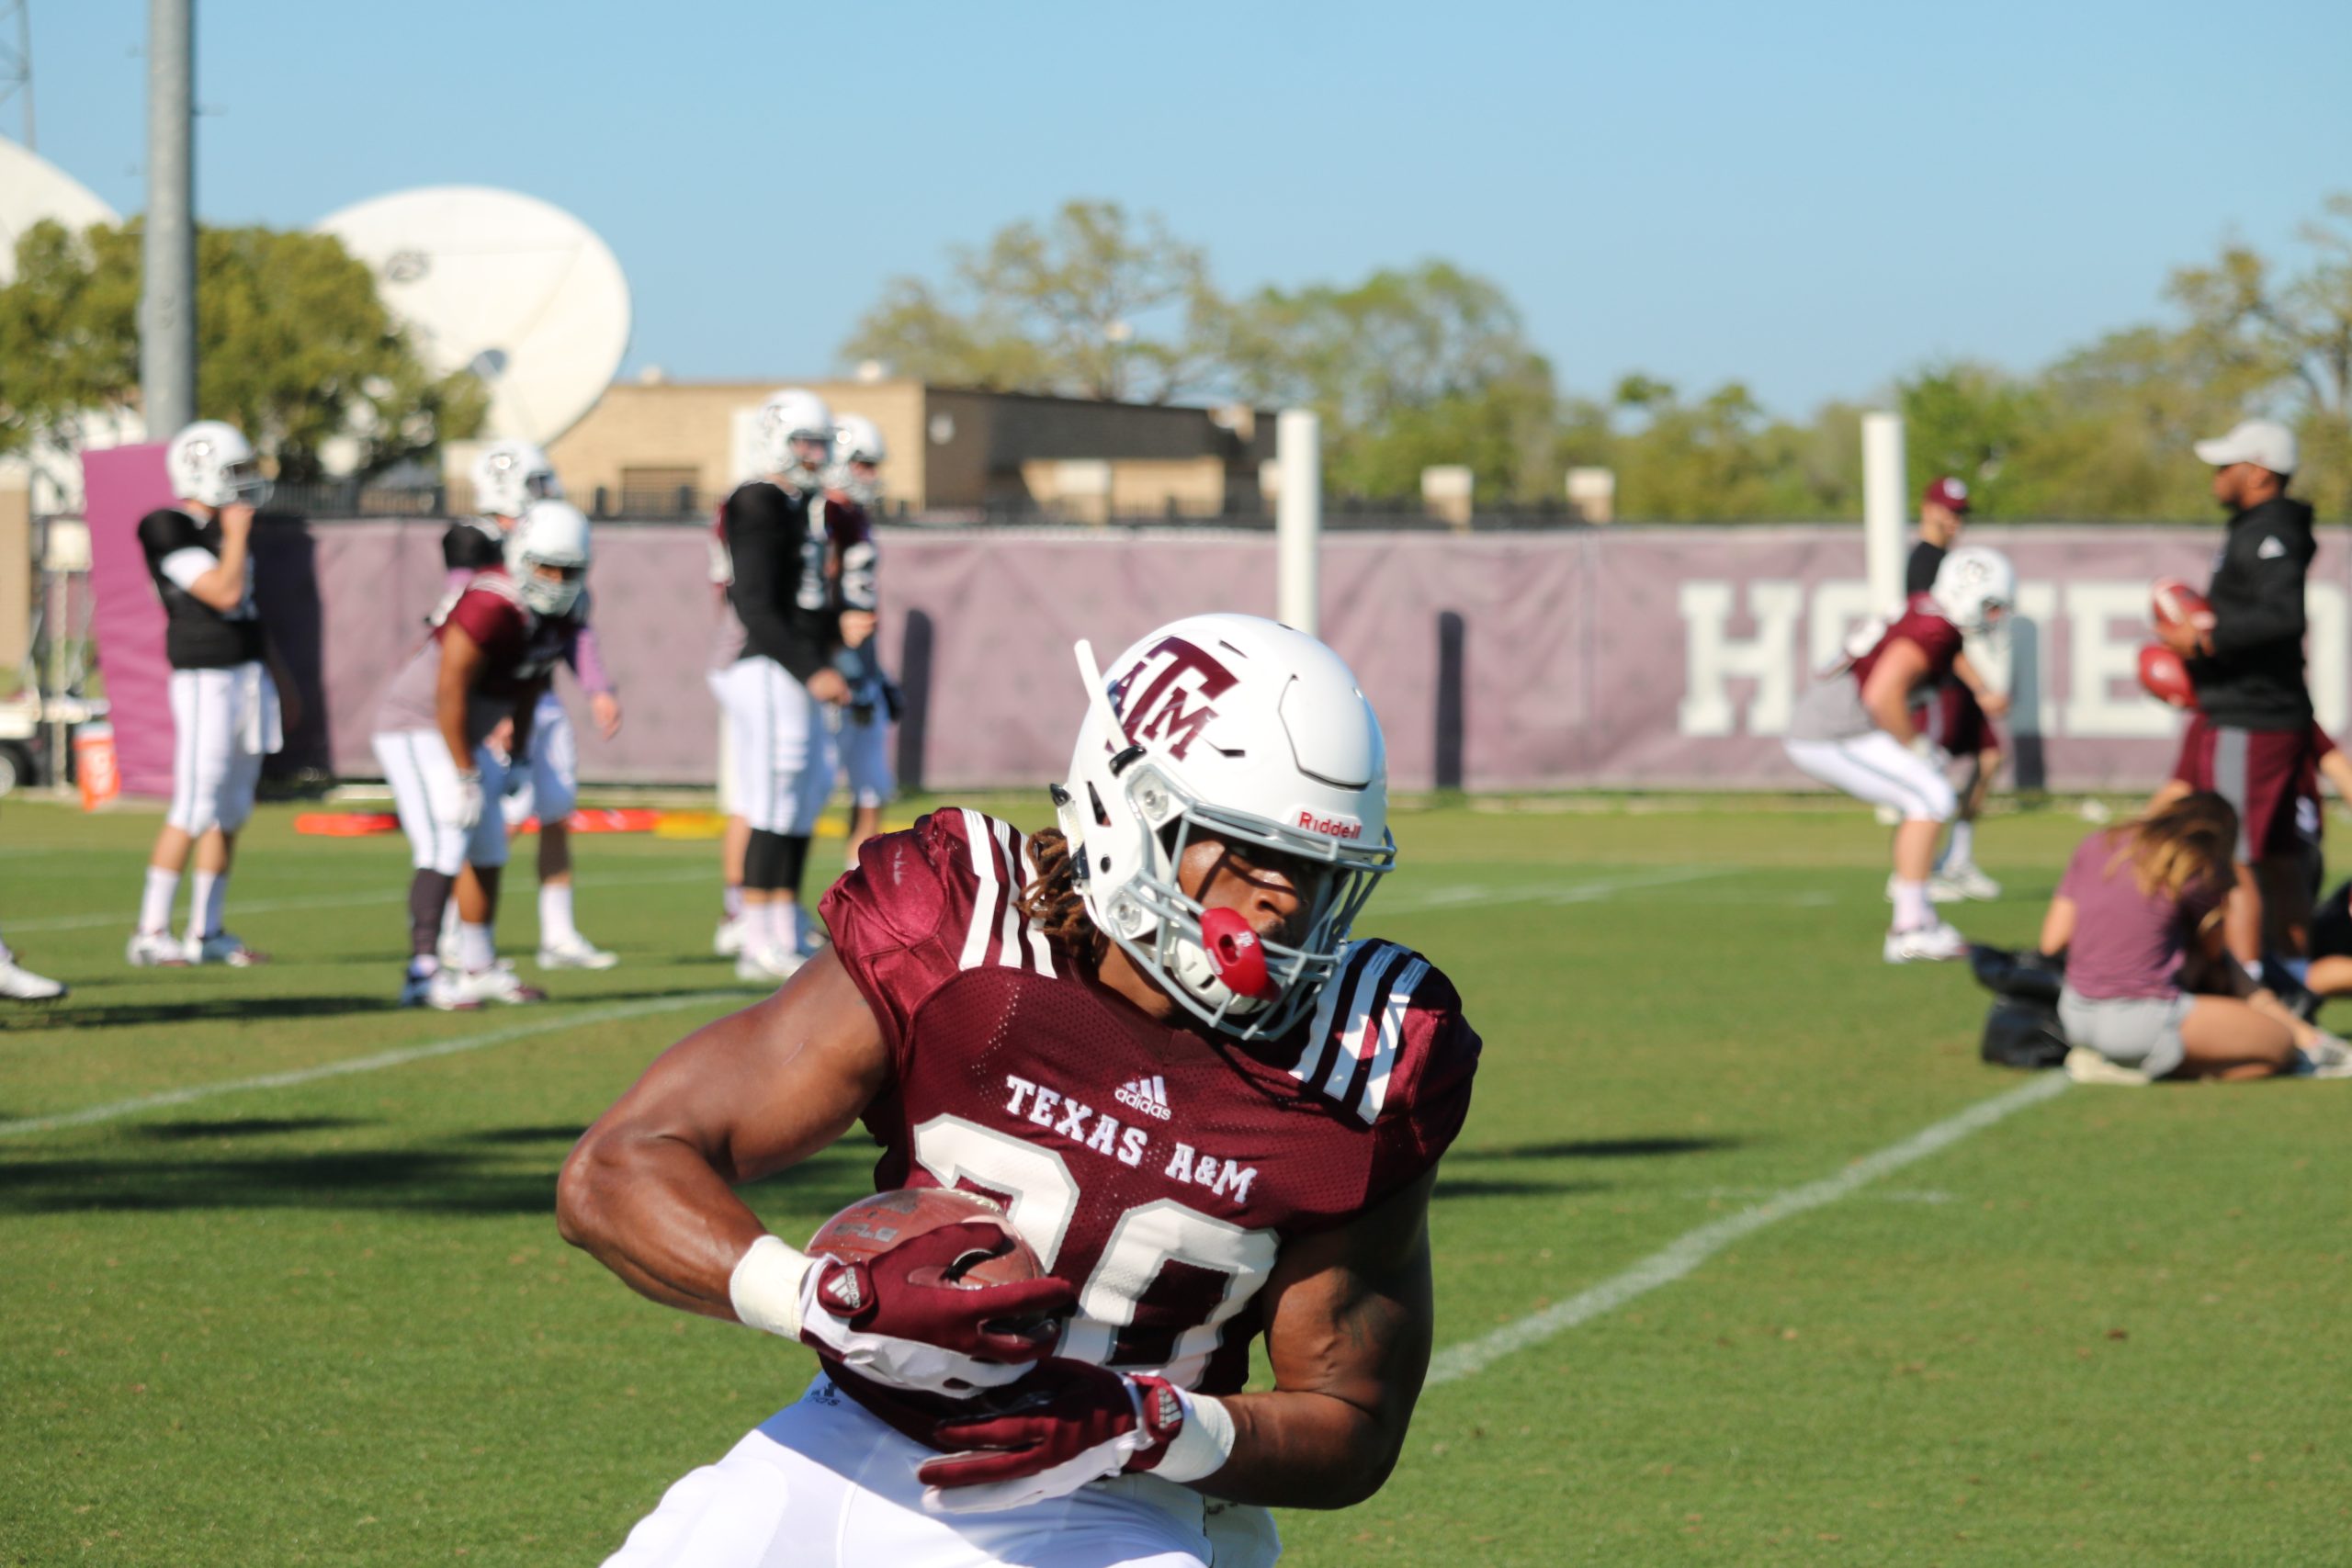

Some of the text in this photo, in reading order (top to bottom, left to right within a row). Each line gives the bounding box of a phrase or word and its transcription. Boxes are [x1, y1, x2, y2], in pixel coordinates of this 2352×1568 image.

[1298, 811, 1363, 840] Riddell
[1114, 1087, 1172, 1121] adidas
[1005, 1074, 1258, 1203] TEXAS A&M
